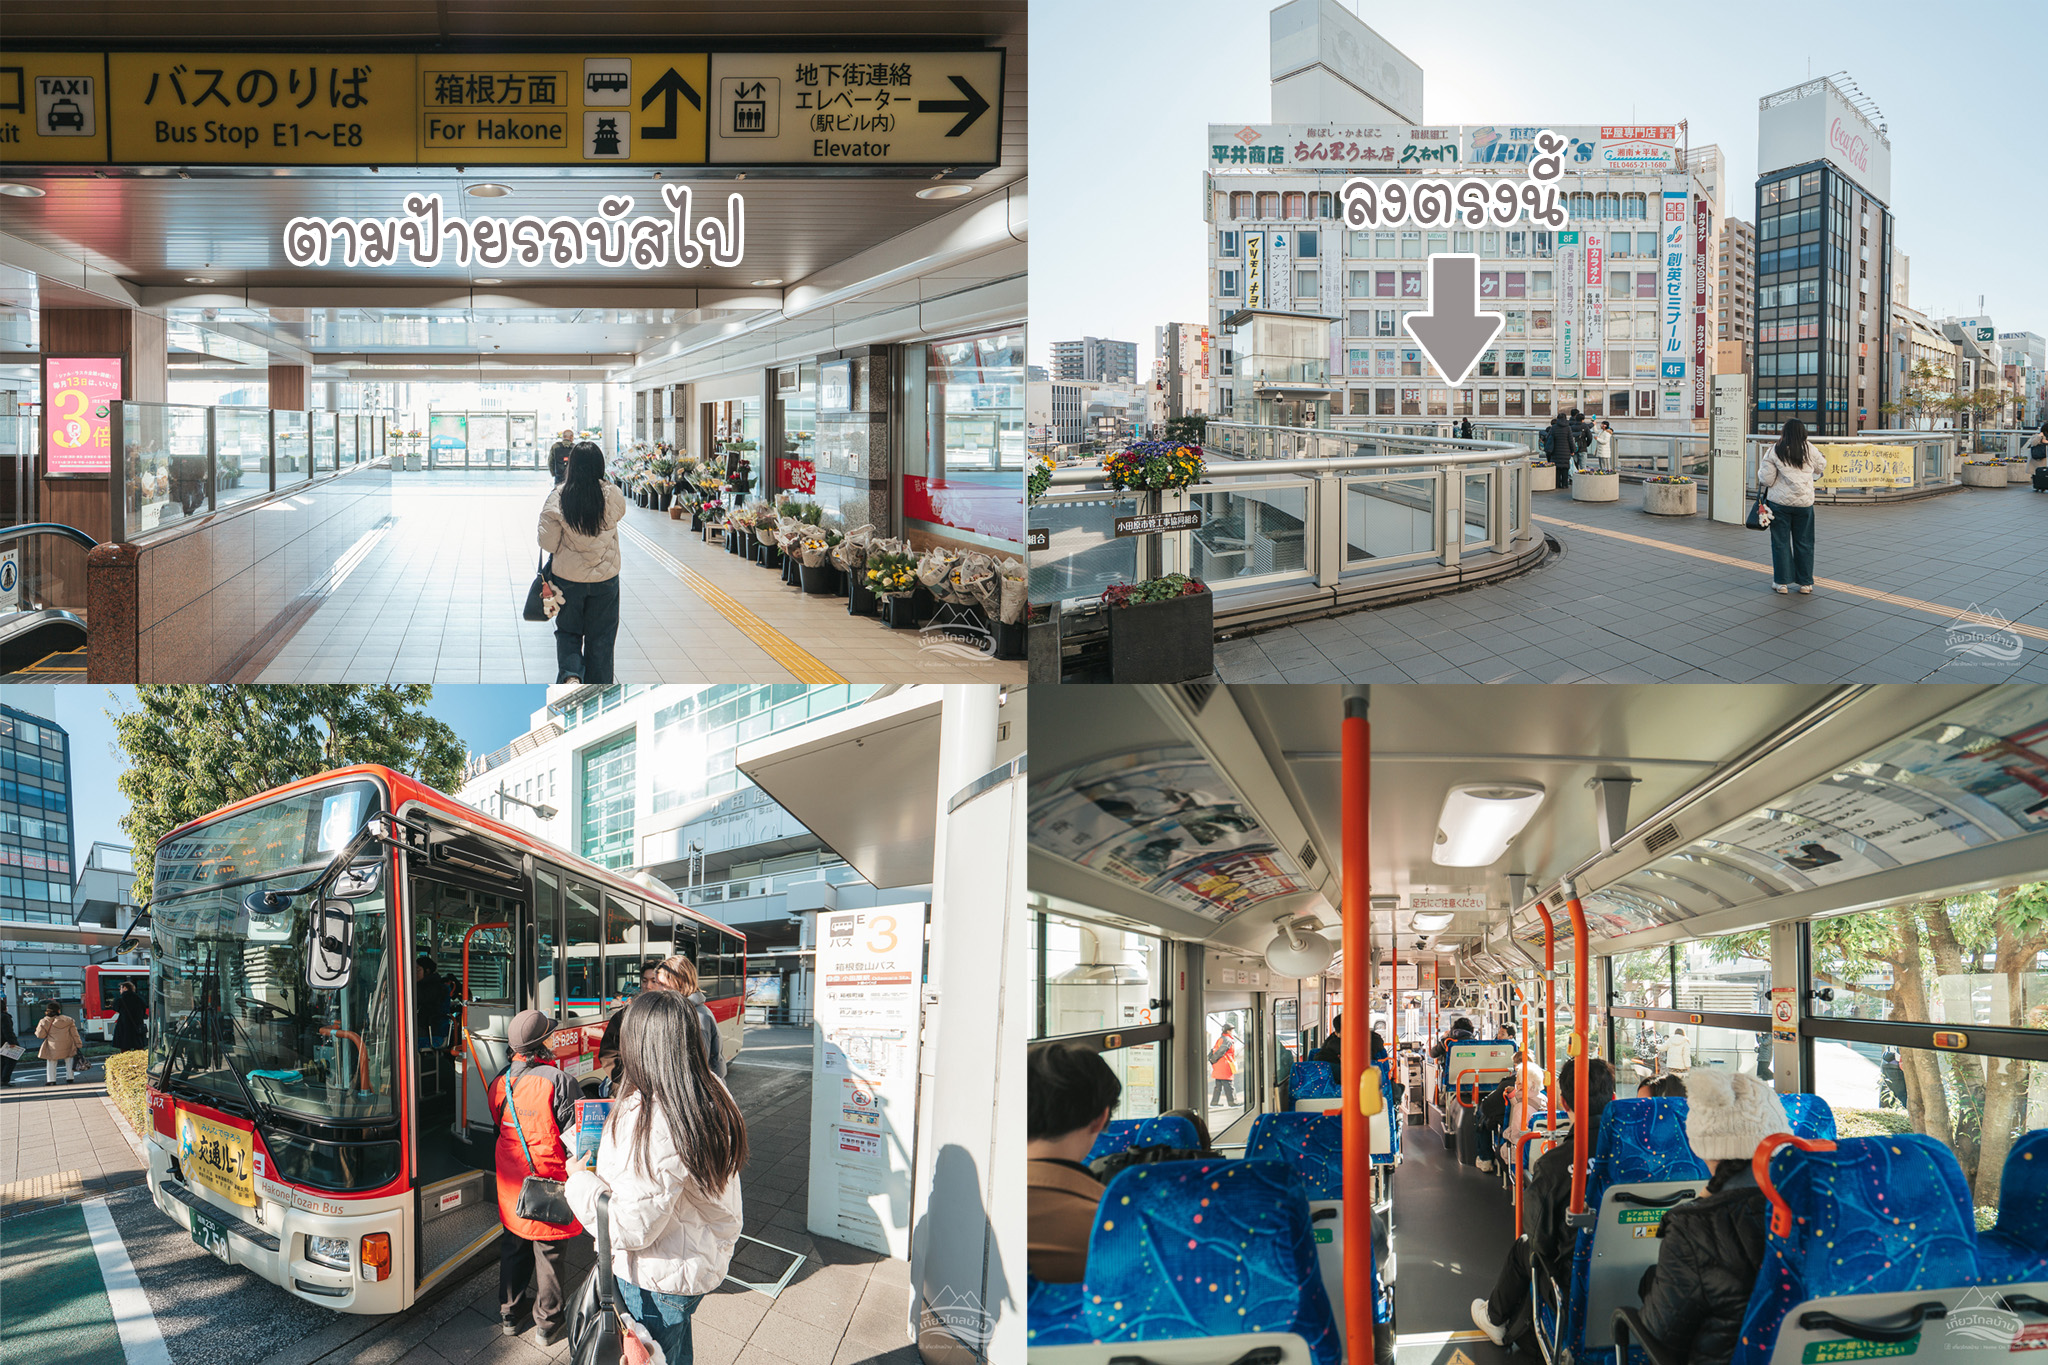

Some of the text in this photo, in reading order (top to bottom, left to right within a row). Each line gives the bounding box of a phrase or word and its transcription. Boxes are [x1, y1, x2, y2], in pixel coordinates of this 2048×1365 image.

[143, 63, 373, 109] バスのりば
[794, 62, 913, 87] 地下街連絡
[40, 79, 89, 96] TAXI
[433, 72, 557, 107] 箱根方面
[794, 88, 911, 112] エレベーター
[155, 120, 197, 144] Bus
[204, 119, 260, 149] Stop
[429, 119, 562, 142] For Hakone
[808, 113, 897, 136] (駅ビル内)
[1601, 126, 1657, 140] 平屋専門店
[813, 139, 891, 158] Elevator
[1211, 145, 1285, 165] 平井商店
[1830, 117, 1870, 174] Coca-Cola
[1608, 161, 1667, 169] TEL 0465-21-1680
[1563, 234, 1574, 243] 8F
[1697, 211, 1707, 243] カラオケ
[1587, 236, 1601, 246] 6F
[1247, 236, 1261, 309] マツモトキヨ
[1590, 248, 1599, 284] カラオケ
[1697, 253, 1706, 295] JOYSOUND
[1666, 252, 1683, 352] 創英ゼミナール
[1696, 323, 1705, 355] カラオケ
[1666, 364, 1682, 376] 4F
[52, 376, 119, 391] 毎月13日は、いい日
[1696, 364, 1705, 407] JOYSOUND
[52, 389, 92, 449] 3
[1116, 513, 1199, 533] 小田原市管工事協同組合
[1412, 897, 1485, 909] 足元にご注意ください
[829, 937, 854, 949] バス
[857, 914, 898, 954] E 3
[835, 961, 897, 972] 箱根登山バス
[1138, 1008, 1152, 1025] 3
[201, 1123, 242, 1144] みんなで守ろう
[198, 1134, 248, 1182] 交通ルール
[261, 1181, 291, 1202] Hakone
[292, 1193, 320, 1212] Tozan
[323, 1202, 344, 1216] Bus
